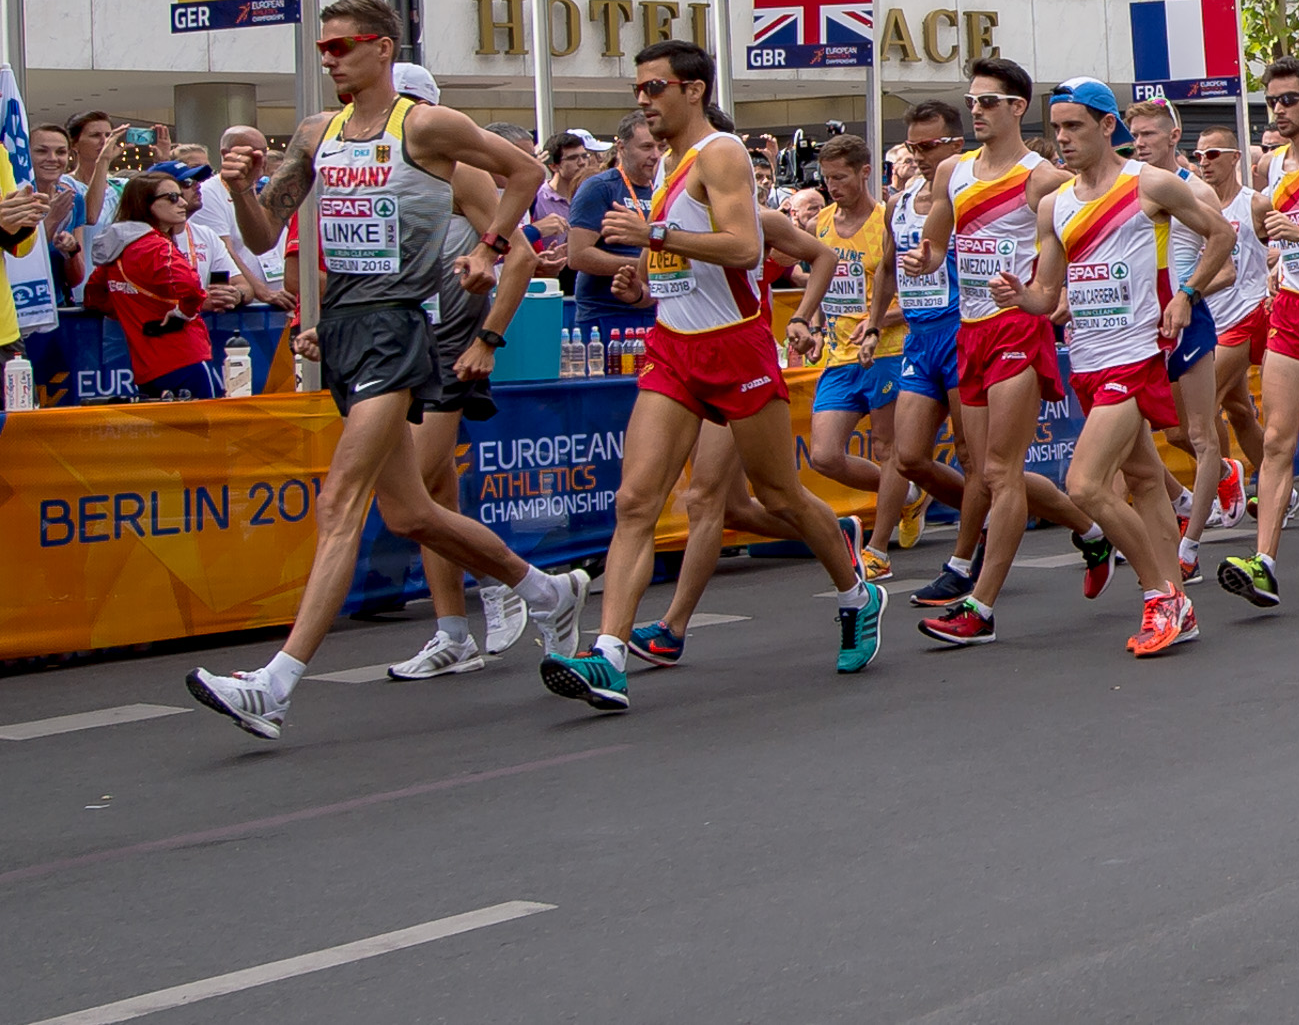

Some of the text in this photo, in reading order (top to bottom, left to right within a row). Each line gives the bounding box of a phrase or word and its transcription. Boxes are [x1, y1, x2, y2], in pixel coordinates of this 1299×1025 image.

[174, 6, 210, 29] GER
[880, 8, 1001, 62] ACE
[750, 48, 786, 66] GBR
[1135, 84, 1166, 100] FRA
[321, 199, 372, 216] SPAR
[324, 222, 380, 243] LINKE
[958, 239, 996, 253] SPAR
[329, 258, 392, 272] BERLIN 2018
[960, 258, 1001, 275] AMEZCUA
[1070, 265, 1109, 281] SPAR
[670, 280, 690, 293] 2018
[924, 297, 943, 307] 2018
[1102, 317, 1128, 329] 2018
[479, 430, 625, 472] EUROPEAN
[480, 465, 597, 501] ATHLETICS
[40, 476, 321, 548] BERLIN 201
[480, 490, 616, 524] CHAMPIONSHIP
